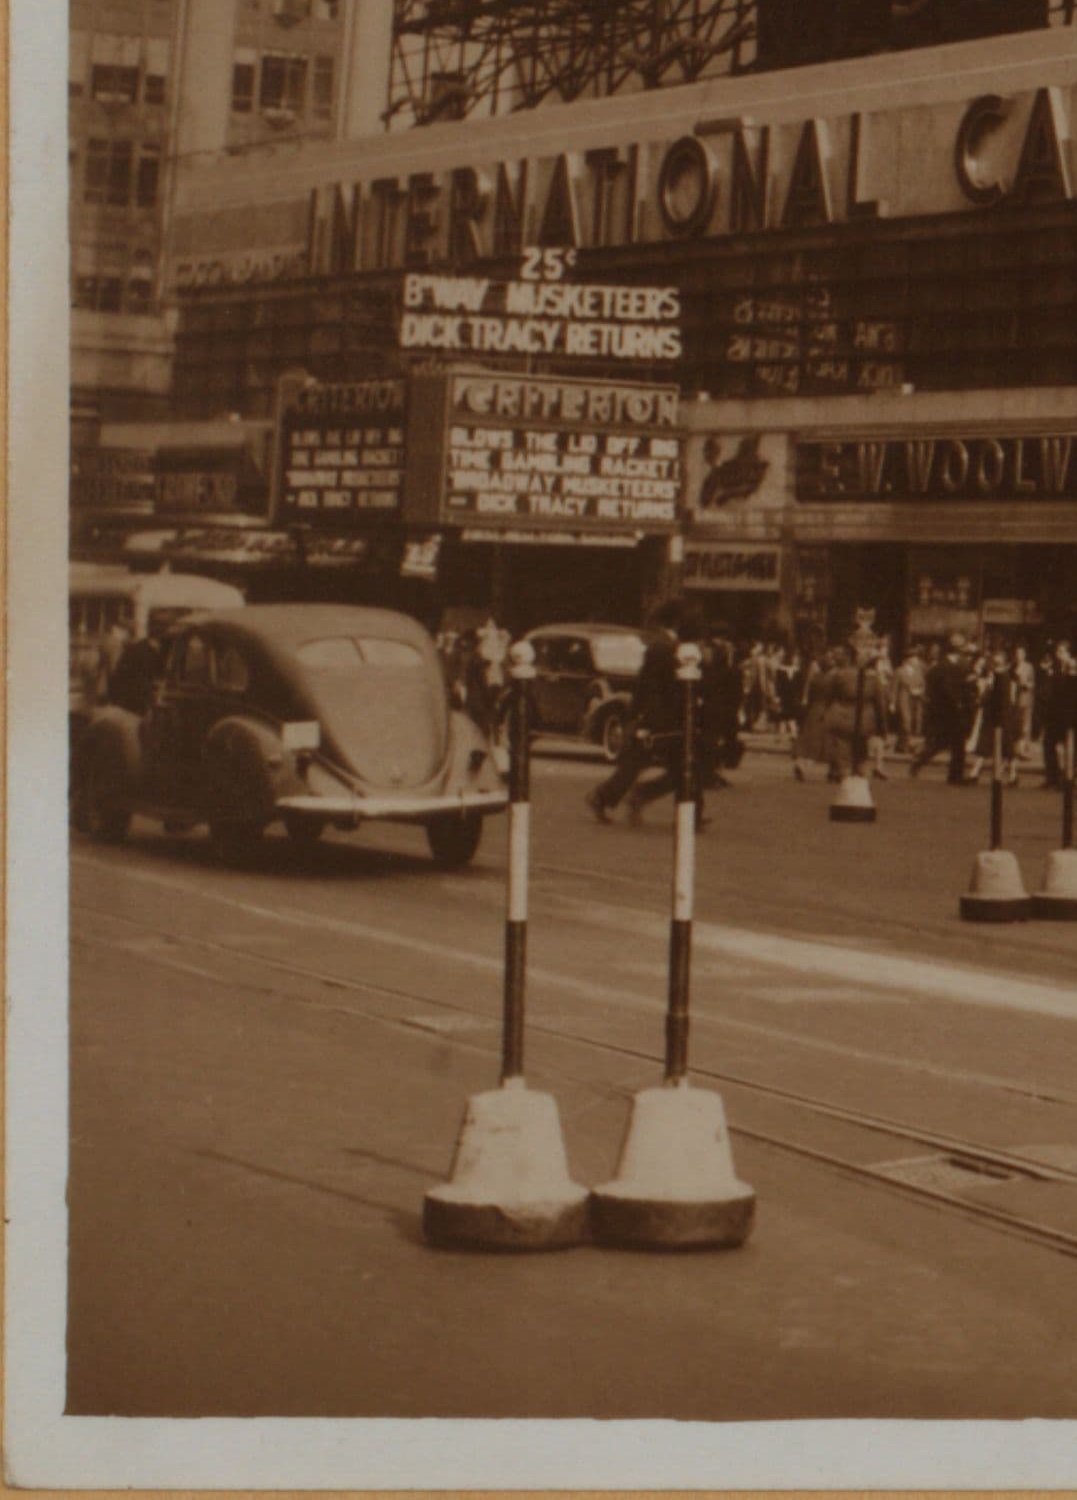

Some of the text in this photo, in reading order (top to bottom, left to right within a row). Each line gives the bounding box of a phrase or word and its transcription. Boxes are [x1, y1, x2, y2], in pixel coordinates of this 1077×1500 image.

[305, 110, 888, 278] INTERNATIONAL
[505, 282, 682, 320] MUSKETEERS
[400, 313, 463, 349] DICK
[466, 317, 561, 354] TRACY
[565, 323, 684, 359] RETURNS
[463, 382, 679, 428] CRITERION
